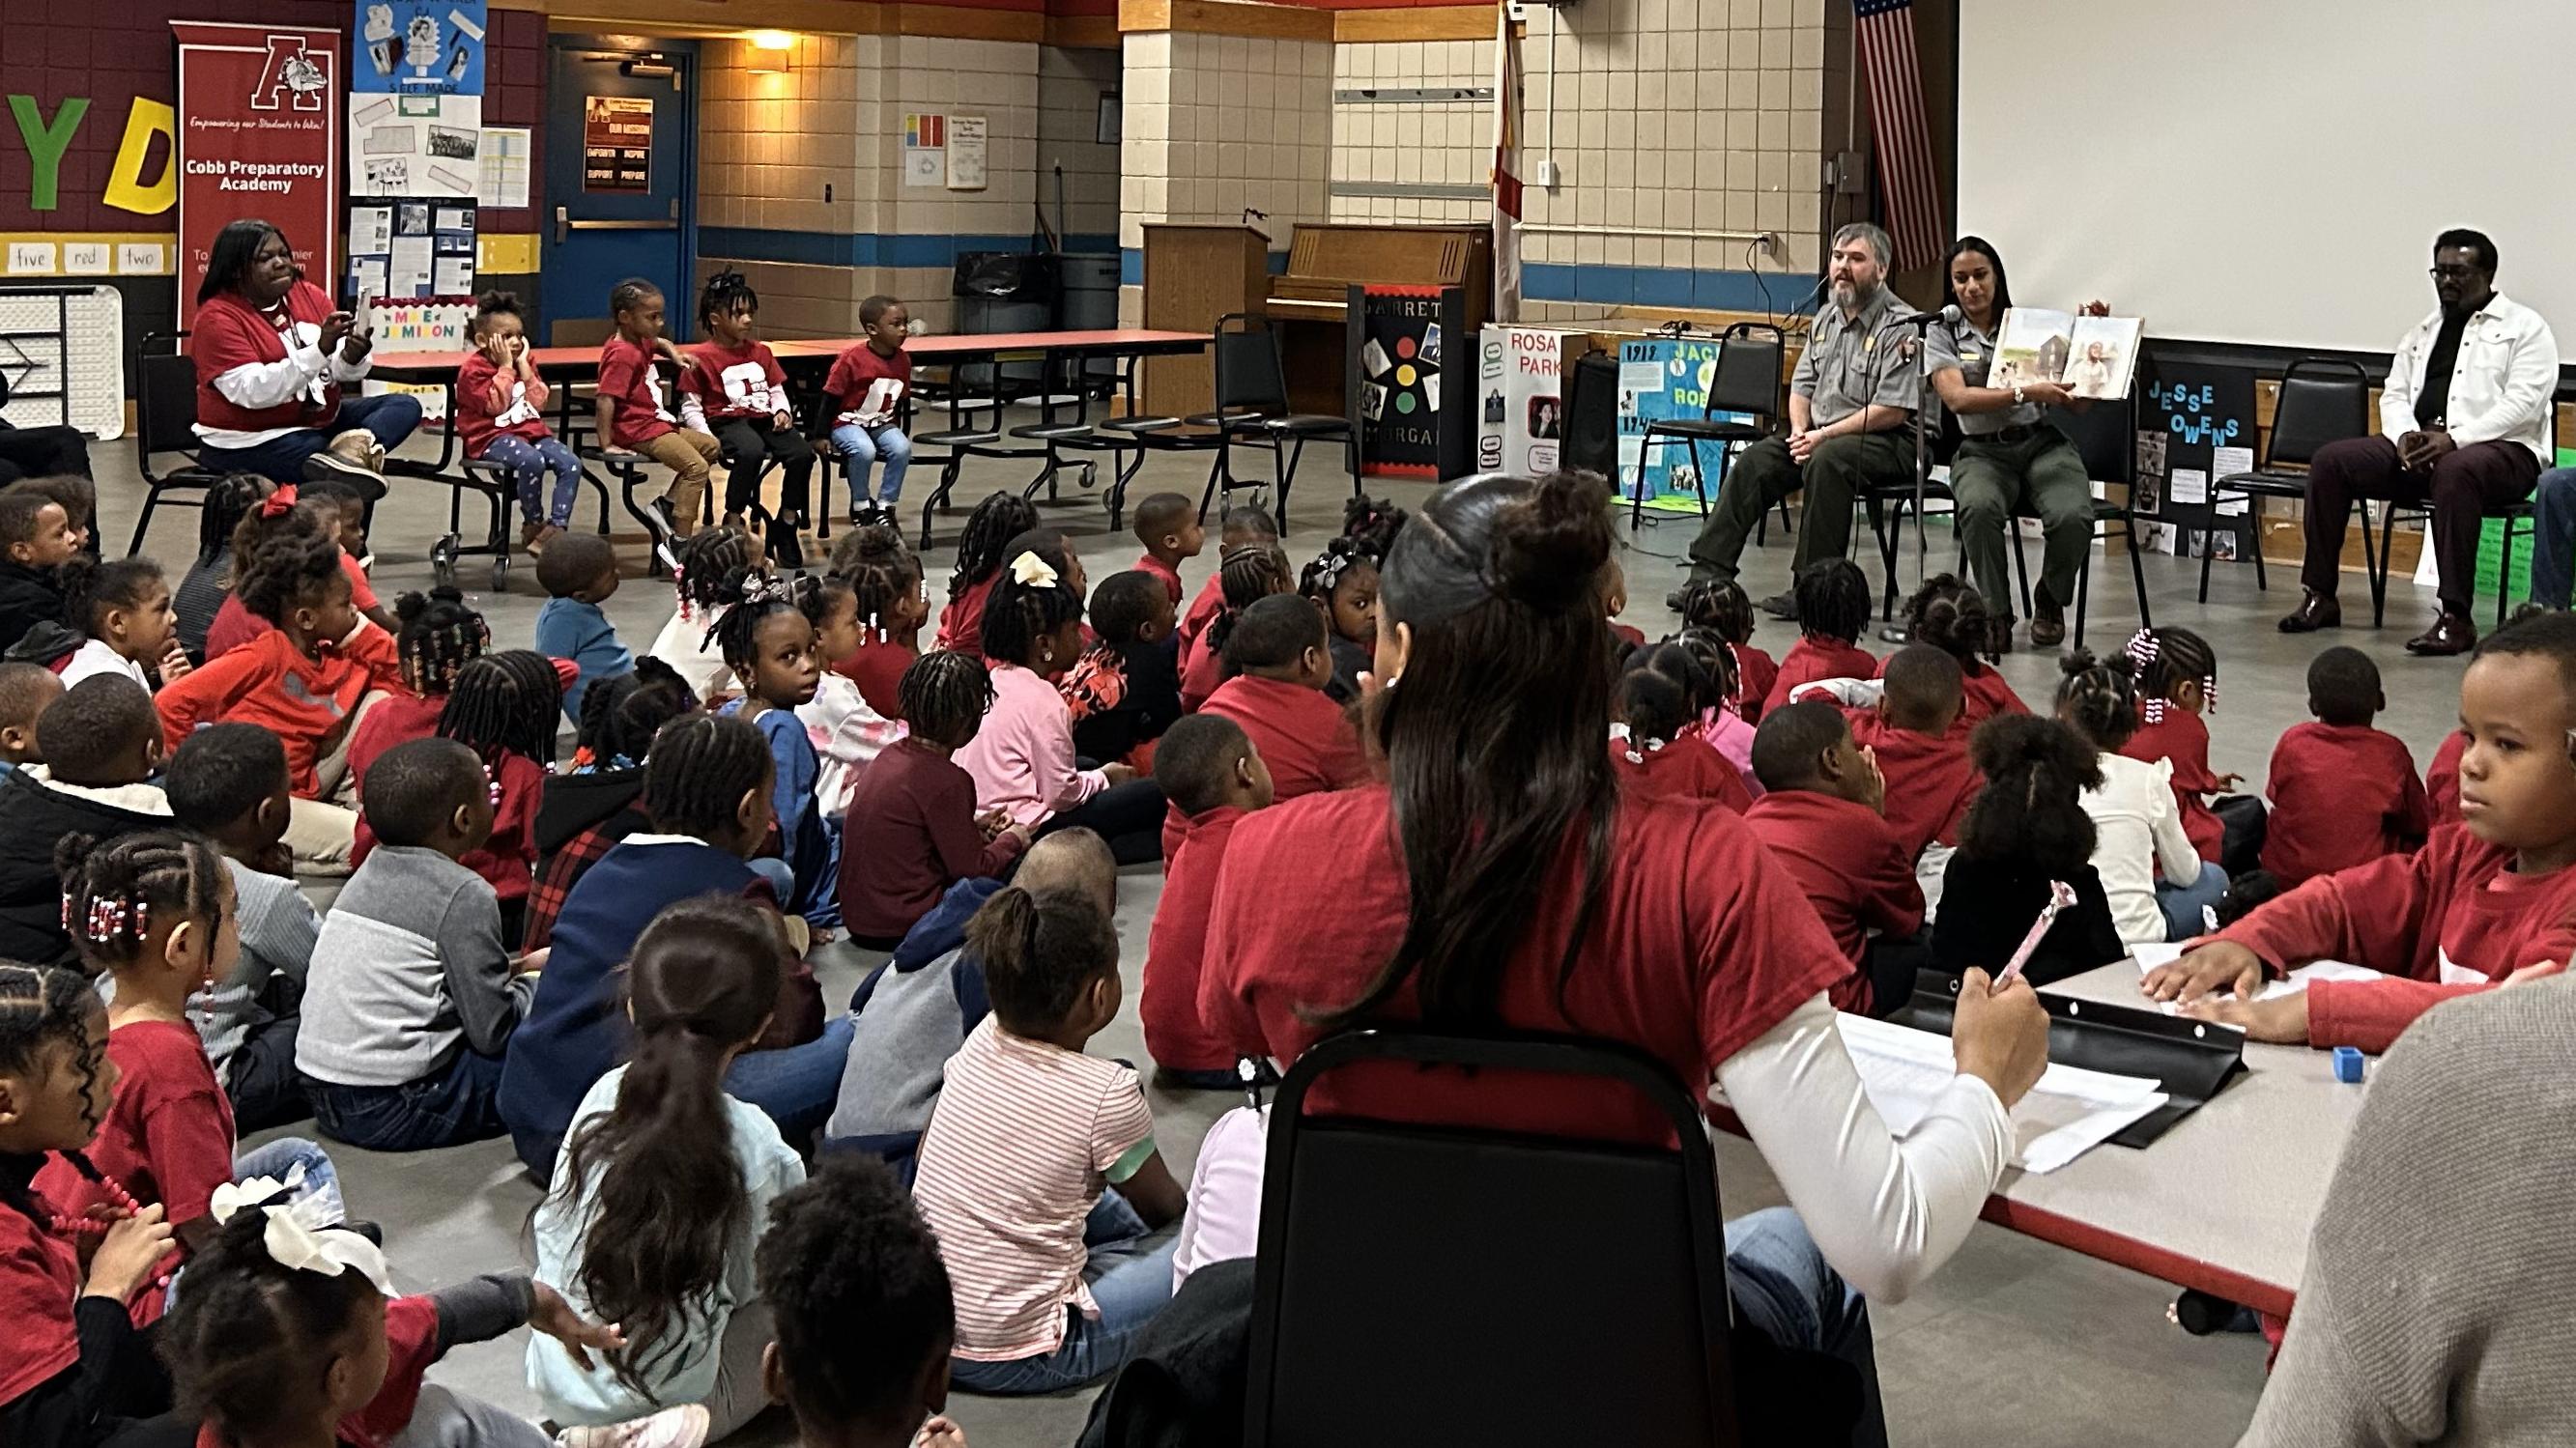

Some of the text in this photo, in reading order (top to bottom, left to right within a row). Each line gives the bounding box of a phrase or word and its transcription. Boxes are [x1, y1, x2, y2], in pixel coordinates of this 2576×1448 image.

[190, 116, 240, 132] Empowering
[186, 159, 325, 179] Cobb Preparatory
[219, 176, 292, 193] Academy
[16, 248, 45, 267] five
[74, 246, 96, 265] red
[126, 249, 155, 266] two
[193, 249, 209, 261] To
[382, 325, 455, 339] JMION
[1511, 332, 1558, 353] ROSA
[1626, 345, 1657, 361] 1919
[2149, 380, 2214, 413] JESSE
[2170, 413, 2239, 447] OWENS
